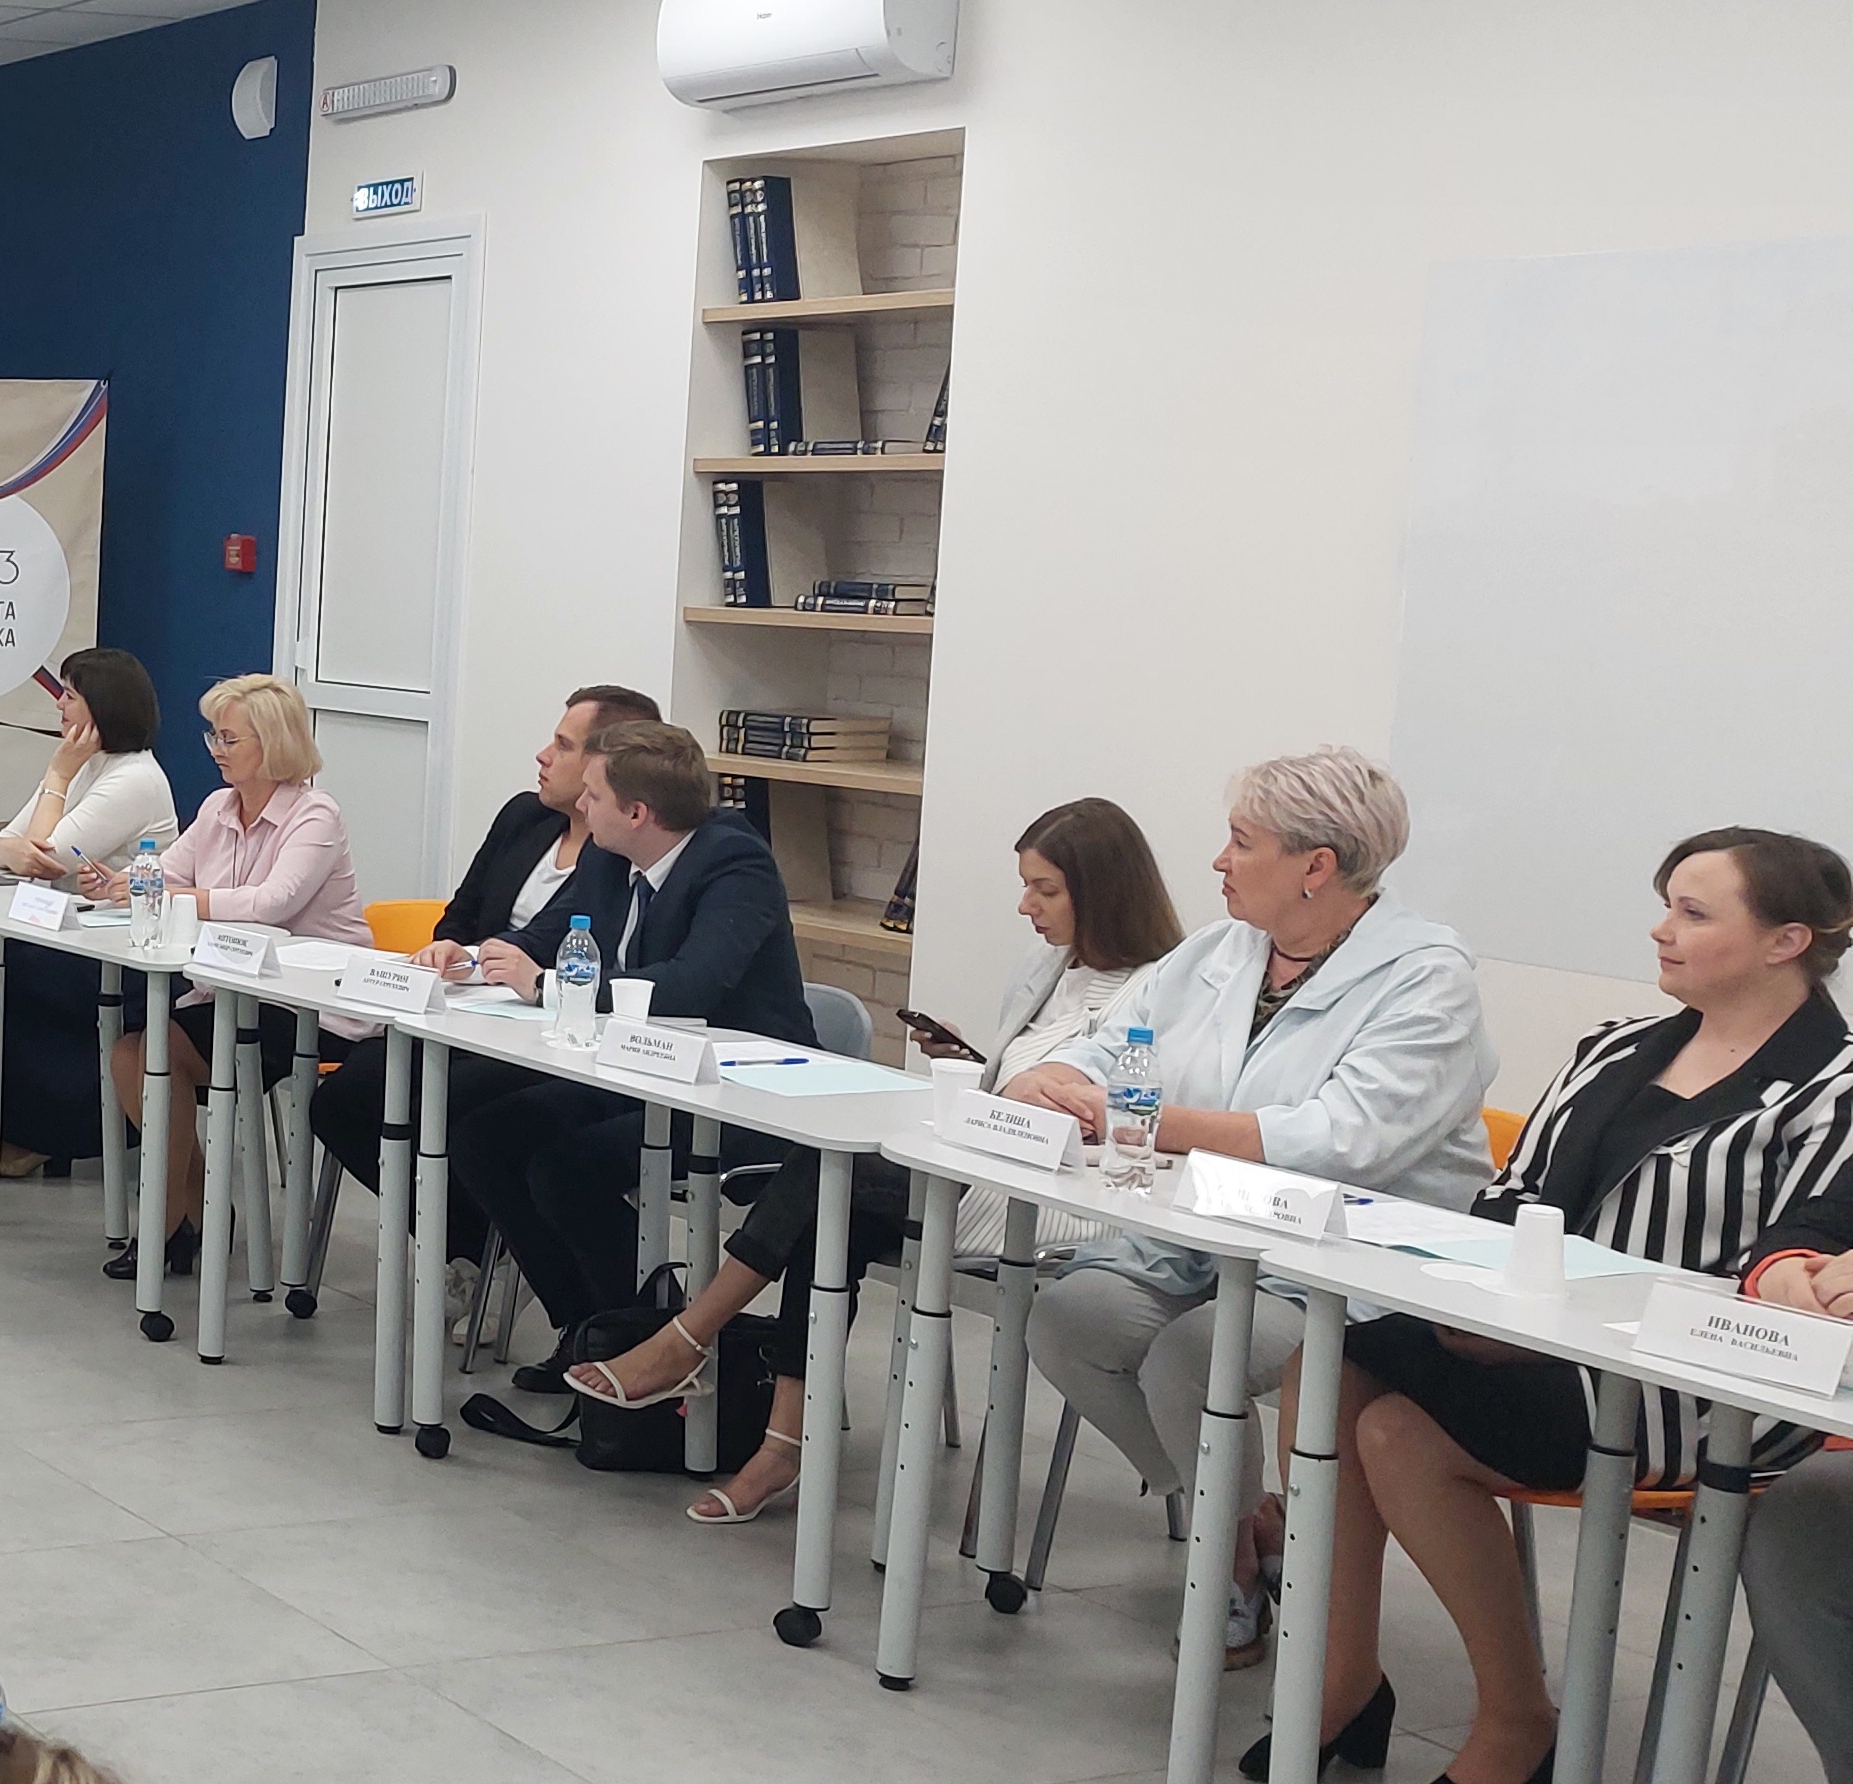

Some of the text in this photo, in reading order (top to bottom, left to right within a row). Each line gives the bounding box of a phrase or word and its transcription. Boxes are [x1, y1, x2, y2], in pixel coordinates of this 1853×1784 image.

[355, 181, 413, 211] ВЫХОД
[1690, 1327, 1798, 1362] ЕЛЕНА ВАСИЛЬЕВНА
[1707, 1315, 1790, 1347] ИВАНОВА
